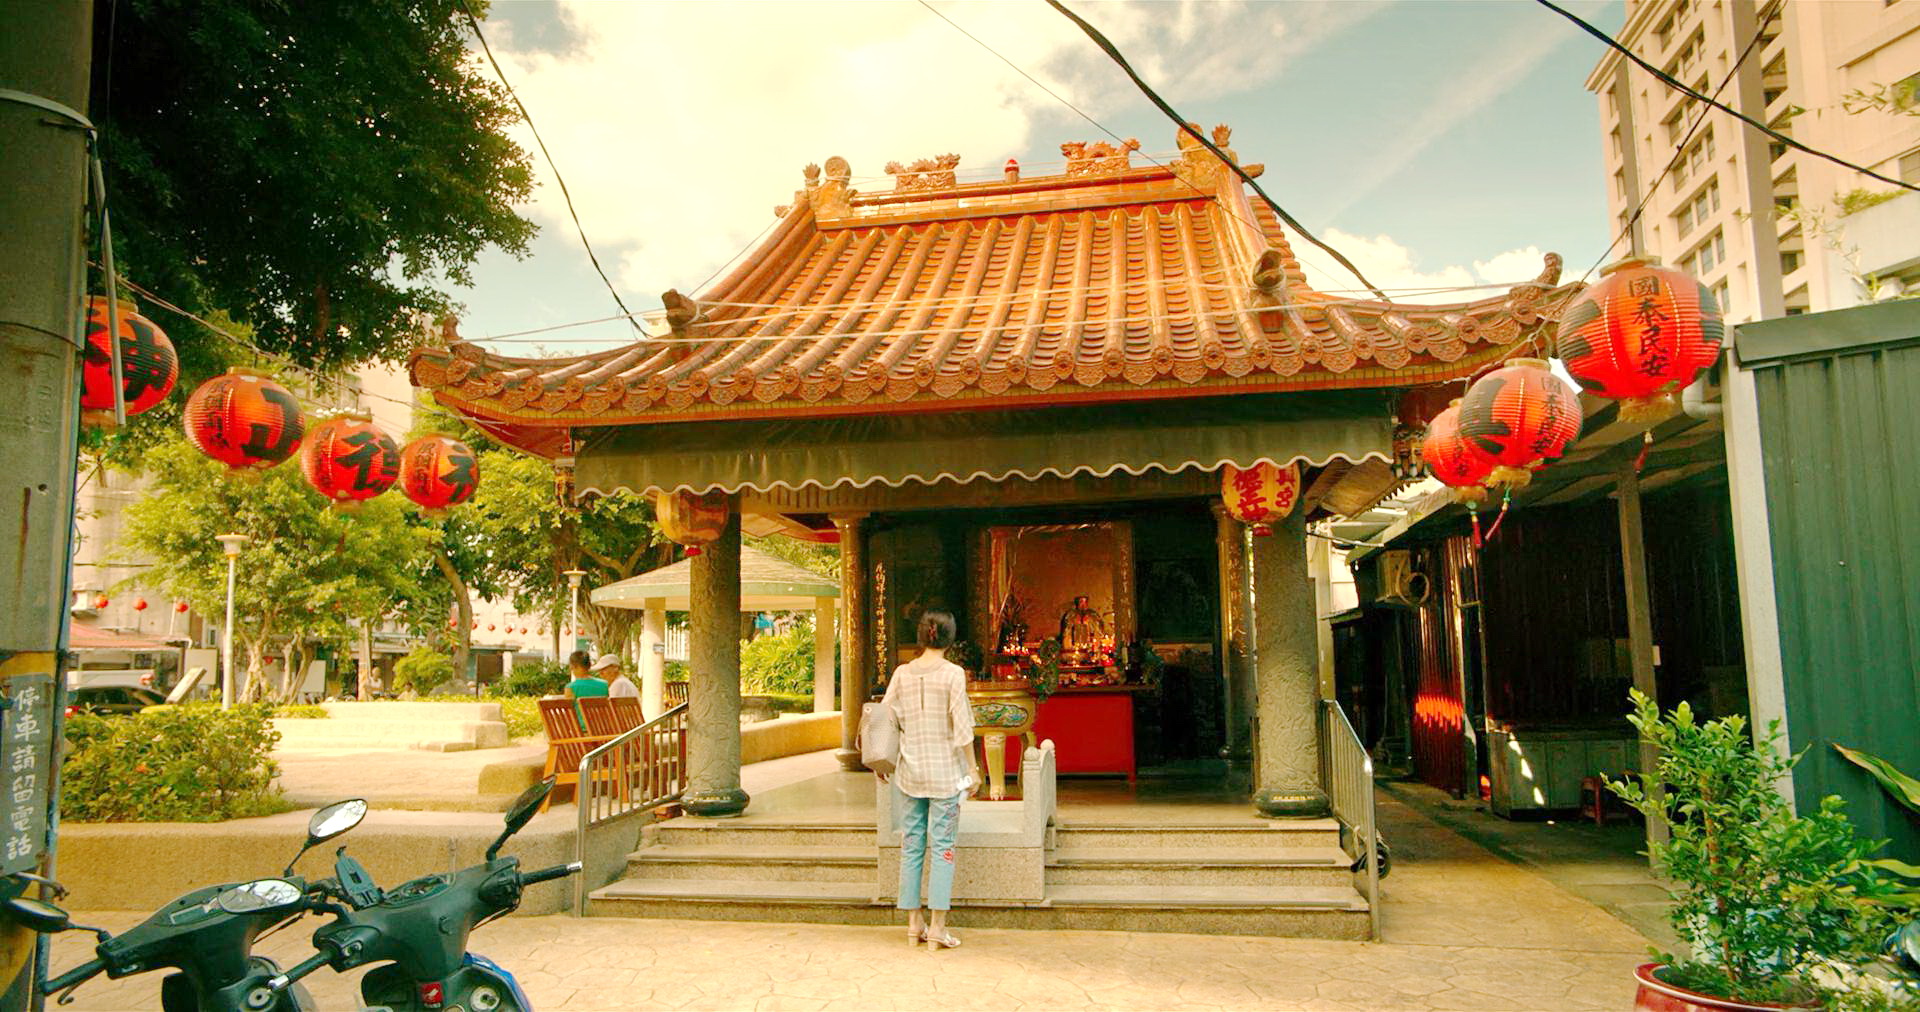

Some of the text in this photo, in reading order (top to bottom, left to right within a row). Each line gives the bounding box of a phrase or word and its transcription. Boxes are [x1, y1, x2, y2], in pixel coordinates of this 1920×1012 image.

[1628, 274, 1669, 377] 國泰民安
[6, 686, 41, 861] 停車請留電話
